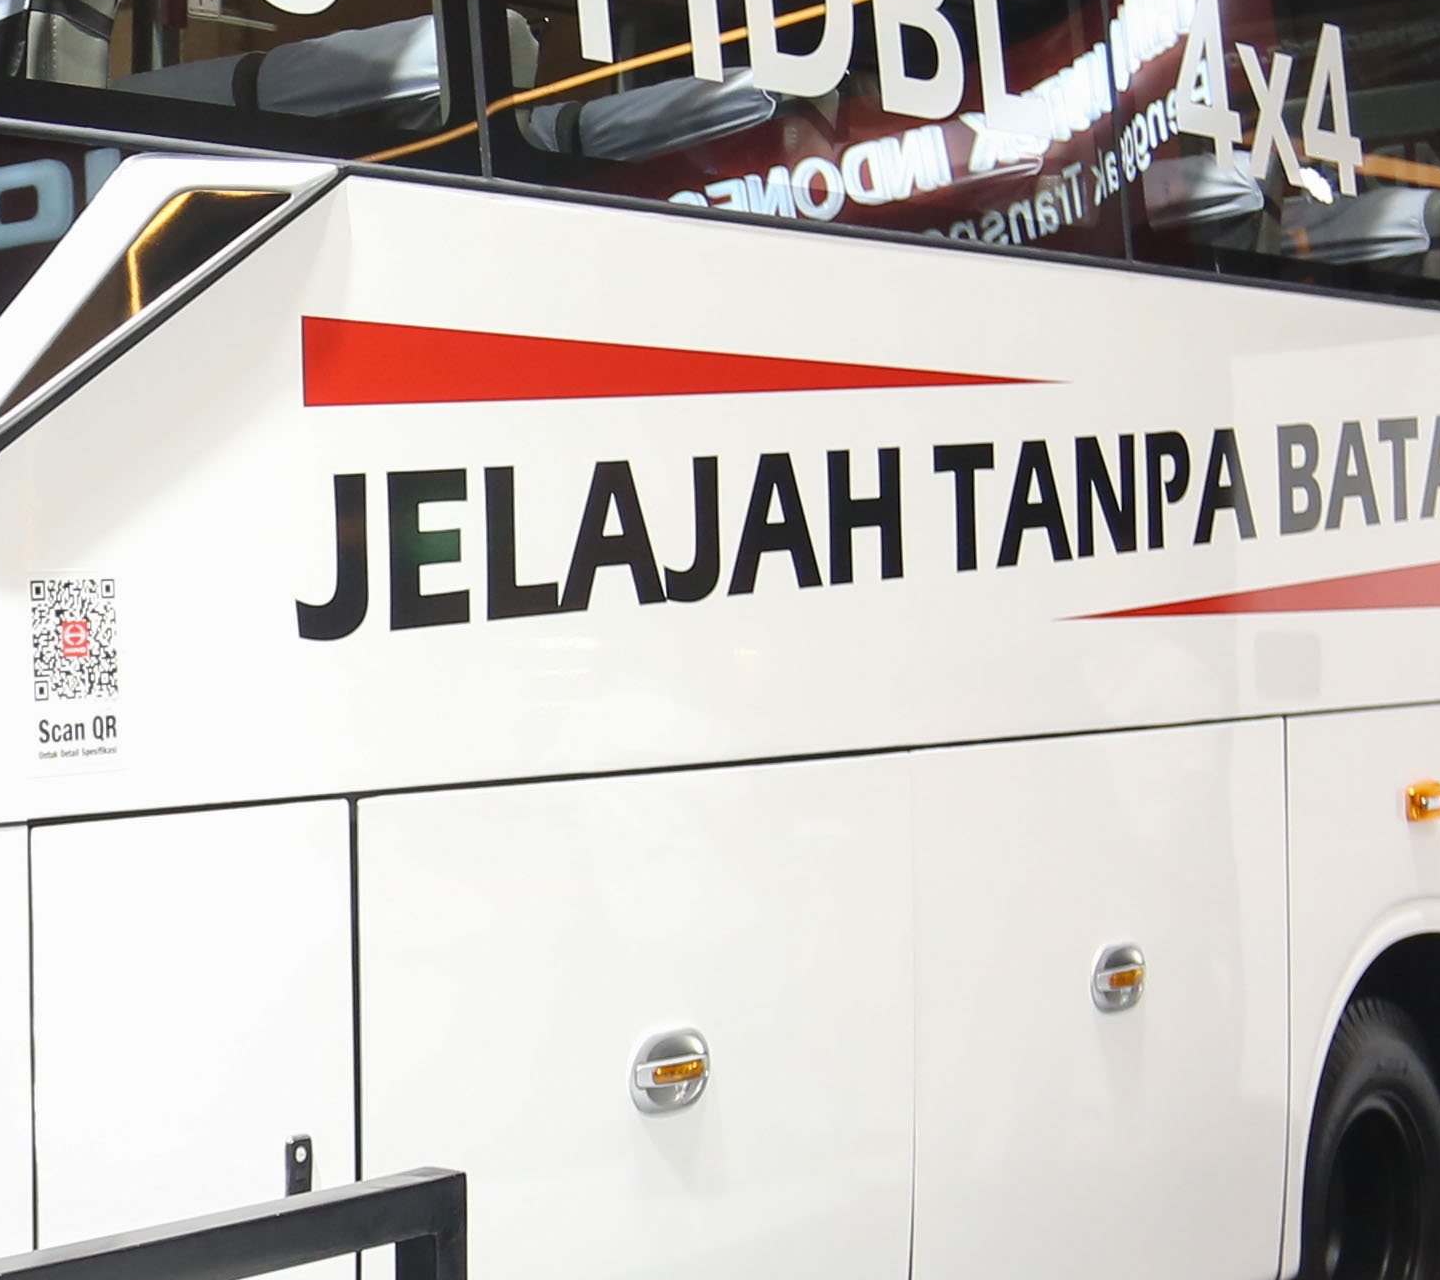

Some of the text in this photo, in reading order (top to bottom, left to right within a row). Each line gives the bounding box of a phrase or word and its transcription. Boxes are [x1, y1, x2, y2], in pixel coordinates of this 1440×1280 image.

[294, 444, 906, 642] JELAJAH
[933, 425, 1258, 574] TANPA
[38, 714, 118, 744] Scan QR
